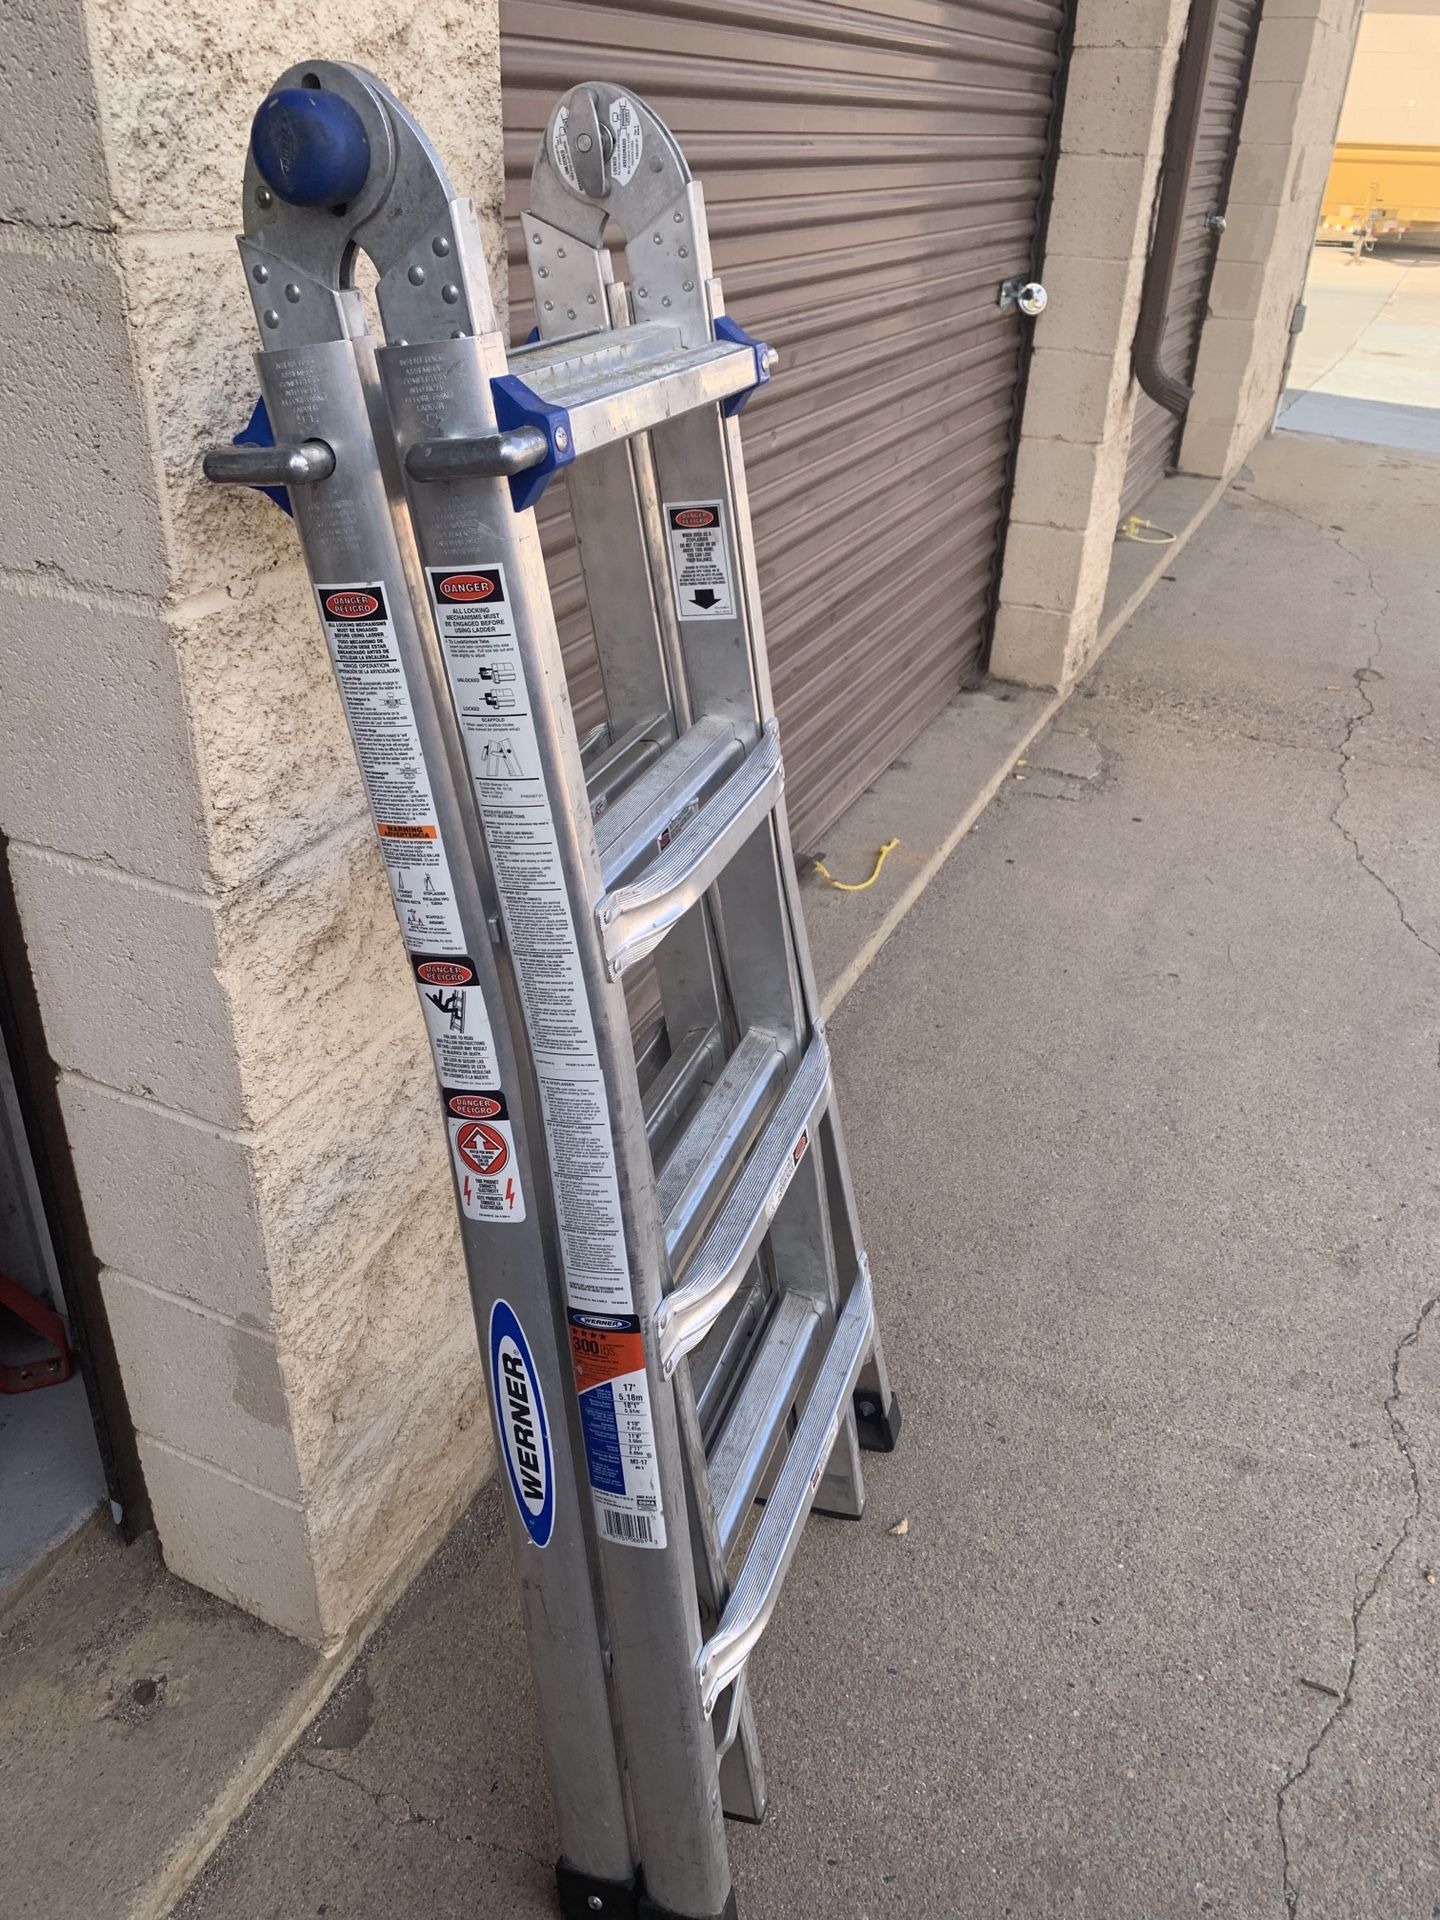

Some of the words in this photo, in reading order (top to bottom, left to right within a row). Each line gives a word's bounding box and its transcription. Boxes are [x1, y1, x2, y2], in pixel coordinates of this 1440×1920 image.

[444, 583, 489, 593] DANGER
[335, 605, 371, 613] PELIGRO
[425, 966, 462, 974] DANGER
[427, 973, 464, 981] PELIGRO
[457, 1099, 491, 1107] DANGER
[457, 1105, 493, 1114] PELIGRO
[585, 1318, 619, 1327] WERNER
[572, 1336, 599, 1355] 300
[619, 1393, 643, 1401] 5.18m
[502, 1352, 544, 1500] WERNER
